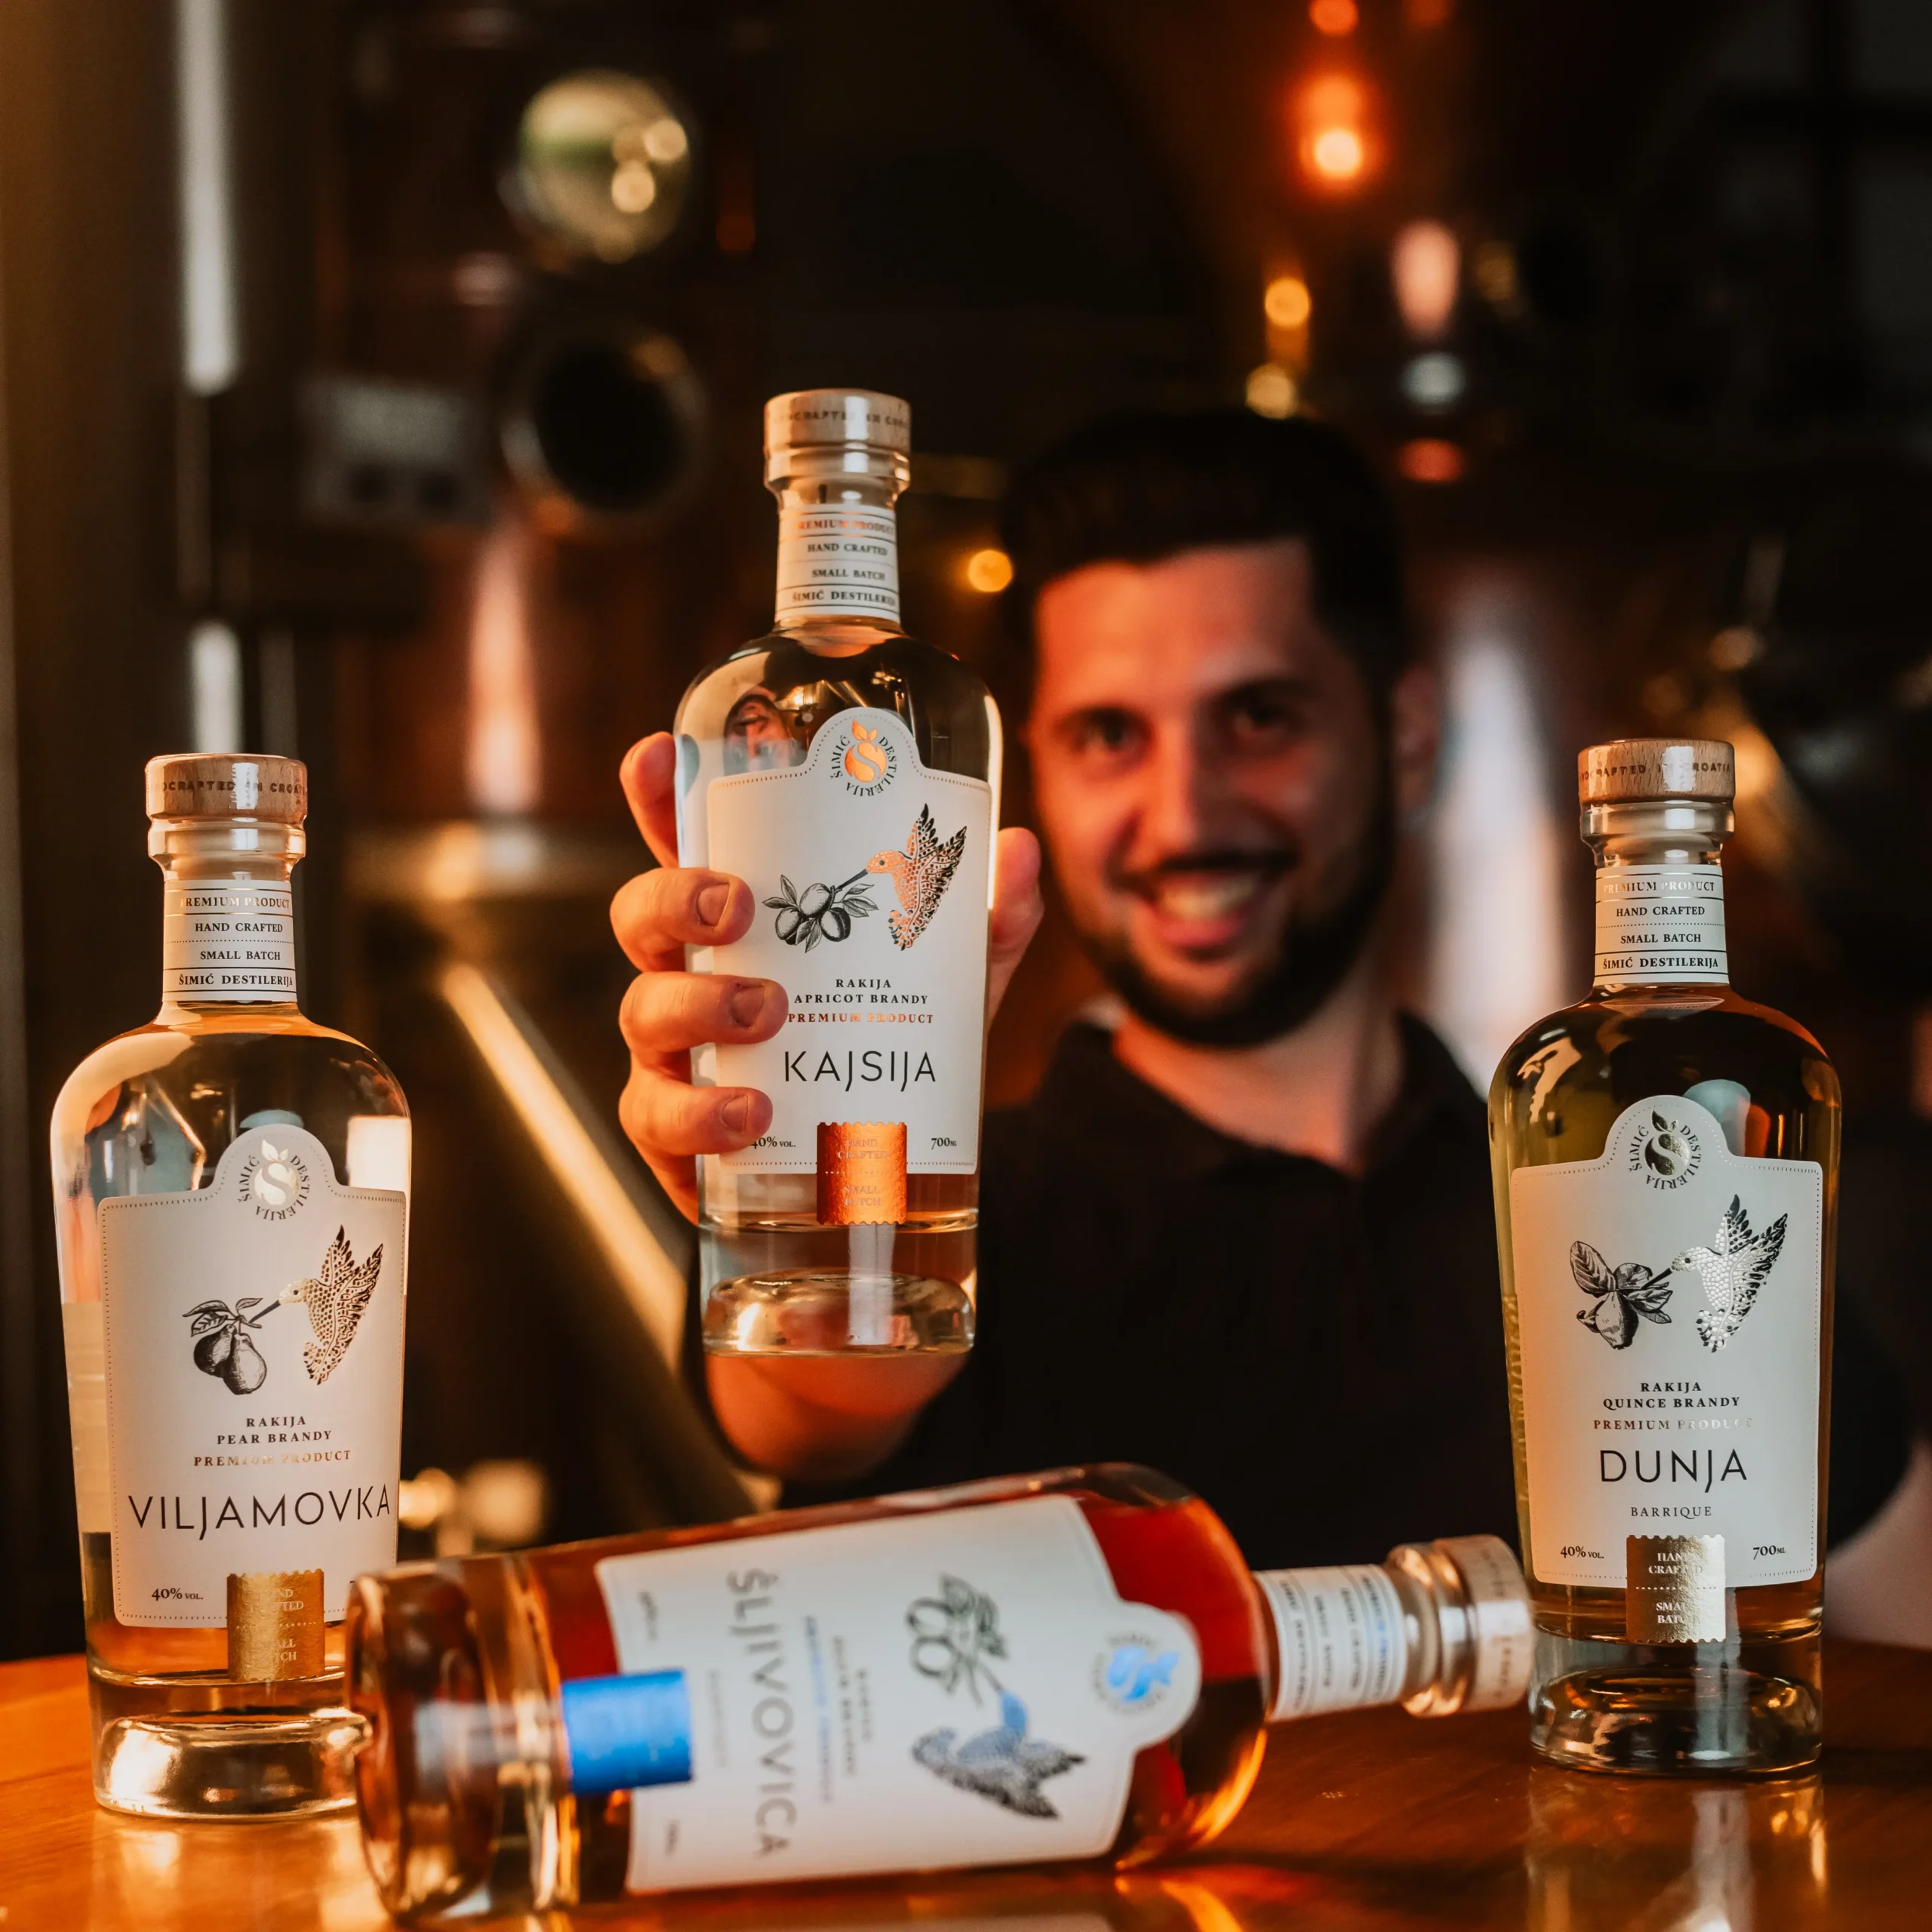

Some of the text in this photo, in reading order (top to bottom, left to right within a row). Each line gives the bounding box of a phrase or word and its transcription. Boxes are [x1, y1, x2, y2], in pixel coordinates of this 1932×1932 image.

[808, 543, 888, 555] HAND CRAFTED
[812, 569, 885, 580] SMALL BATCH
[792, 589, 824, 601] ŠIMIĆ
[829, 734, 897, 797] ŠIMIĆ DESTILERIJA
[1604, 881, 1715, 894] PREMIUM PRODUCT
[245, 897, 290, 908] PRODUCT
[1617, 906, 1705, 917] HAND CRAFTED
[195, 922, 283, 933] HAND CRAFTED
[1620, 934, 1701, 944] SMALL BATCH
[200, 950, 281, 960] SMALL BATCH
[1603, 957, 1718, 969] ŠIMIĆ DESTILERIJA
[179, 974, 293, 987] ŠIMIĆ DESTILERIJA
[835, 979, 891, 989] RAKIJA
[794, 994, 928, 1004] APRICOT BRANDY
[788, 1014, 934, 1023] PREMIUM PRODUCT
[785, 1051, 936, 1092] KAJSIJA
[1629, 1124, 1701, 1190] ŠIMIĆ DESTILERIJA
[237, 1155, 310, 1220] ŠIMIĆ DESTILERIJA
[1640, 1382, 1702, 1393] RAKIJA
[1603, 1397, 1740, 1411] QUINCE BRANDY
[246, 1416, 306, 1428] RAKIJA
[1593, 1418, 1752, 1430] PREMIUM PRODUCT
[217, 1430, 331, 1444] PEAR BRANDY
[194, 1450, 351, 1466] PREMIUM PRODUCT
[1600, 1449, 1747, 1493] DUNJA
[128, 1483, 390, 1540] VILJAMOVKA
[1630, 1506, 1712, 1519] BARRIQUE
[1560, 1546, 1586, 1558] 40%
[152, 1587, 183, 1601] 40%
[726, 1567, 798, 1860] ŠLJIVOVICA
